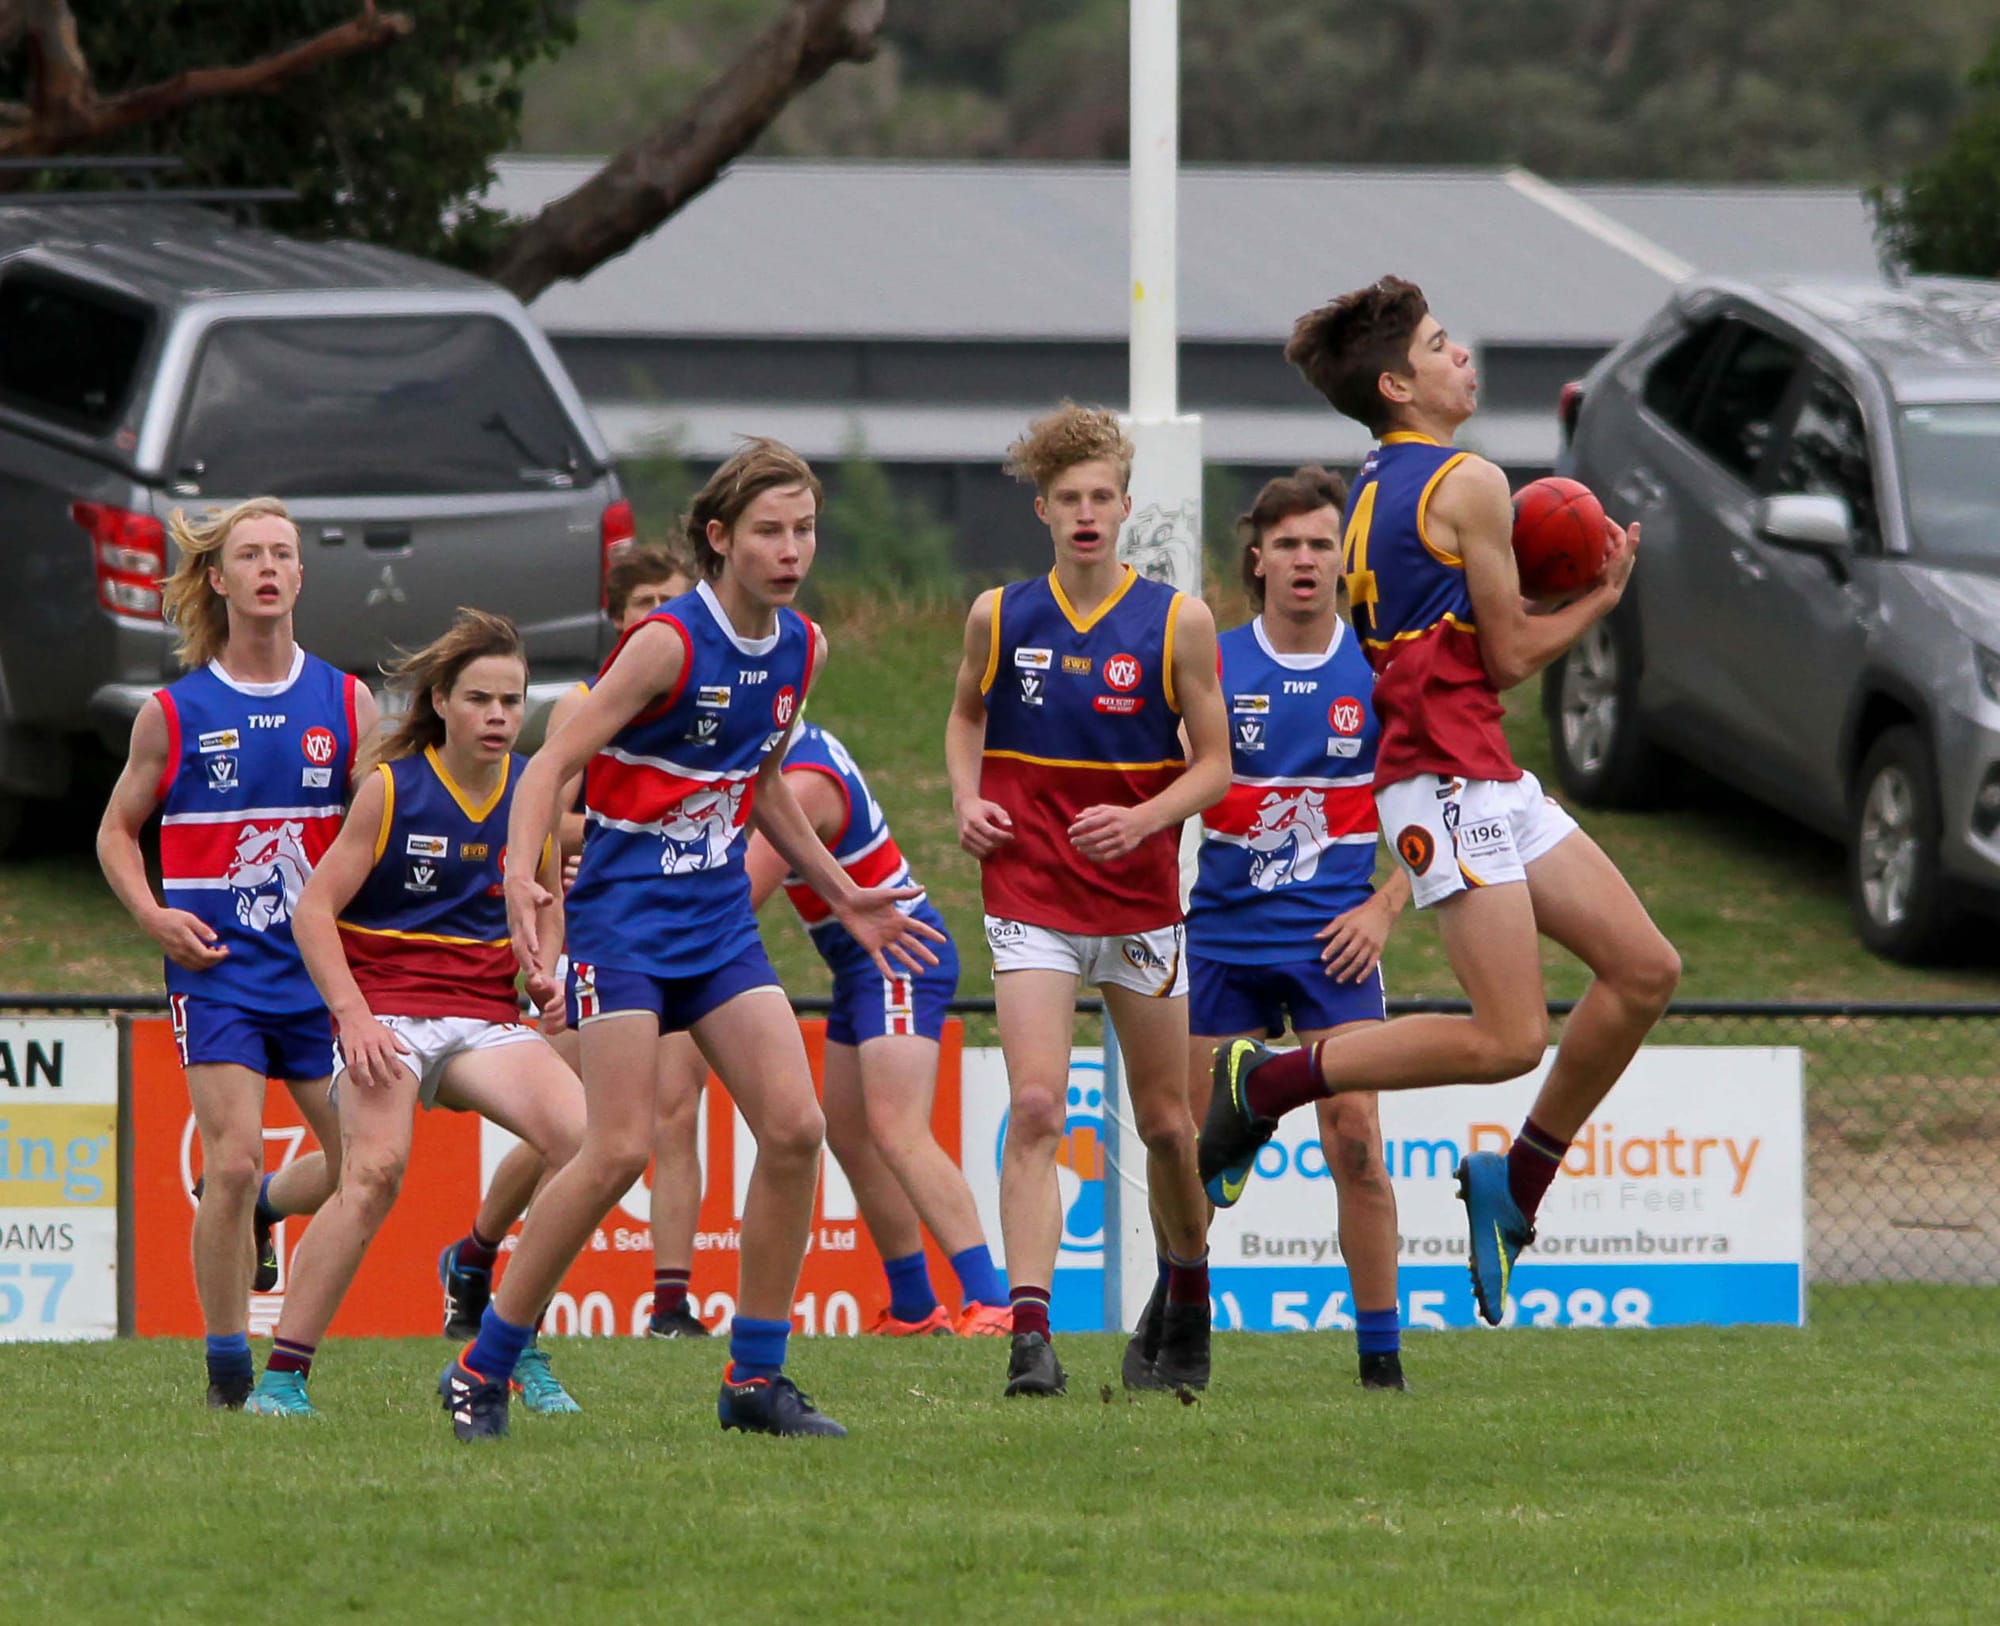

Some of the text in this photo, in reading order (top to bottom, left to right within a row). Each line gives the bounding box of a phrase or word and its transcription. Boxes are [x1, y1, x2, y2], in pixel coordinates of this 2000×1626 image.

[1343, 481, 1379, 630] 4
[738, 671, 768, 684] TWP
[1282, 681, 1318, 694] TWP
[248, 714, 286, 728] TWP
[1471, 823, 1506, 843] 196
[0, 1119, 109, 1201] ing
[1620, 1182, 1705, 1212] Feet
[0, 1223, 74, 1250] AMS
[591, 1229, 608, 1251] &
[614, 1227, 653, 1251] Sol
[820, 1229, 857, 1250] Ltd
[1240, 1233, 1338, 1262] Bunyi
[1397, 1234, 1469, 1254] rou
[544, 1291, 615, 1338] 00
[787, 1291, 860, 1338] 10
[1272, 1290, 1447, 1331] 565
